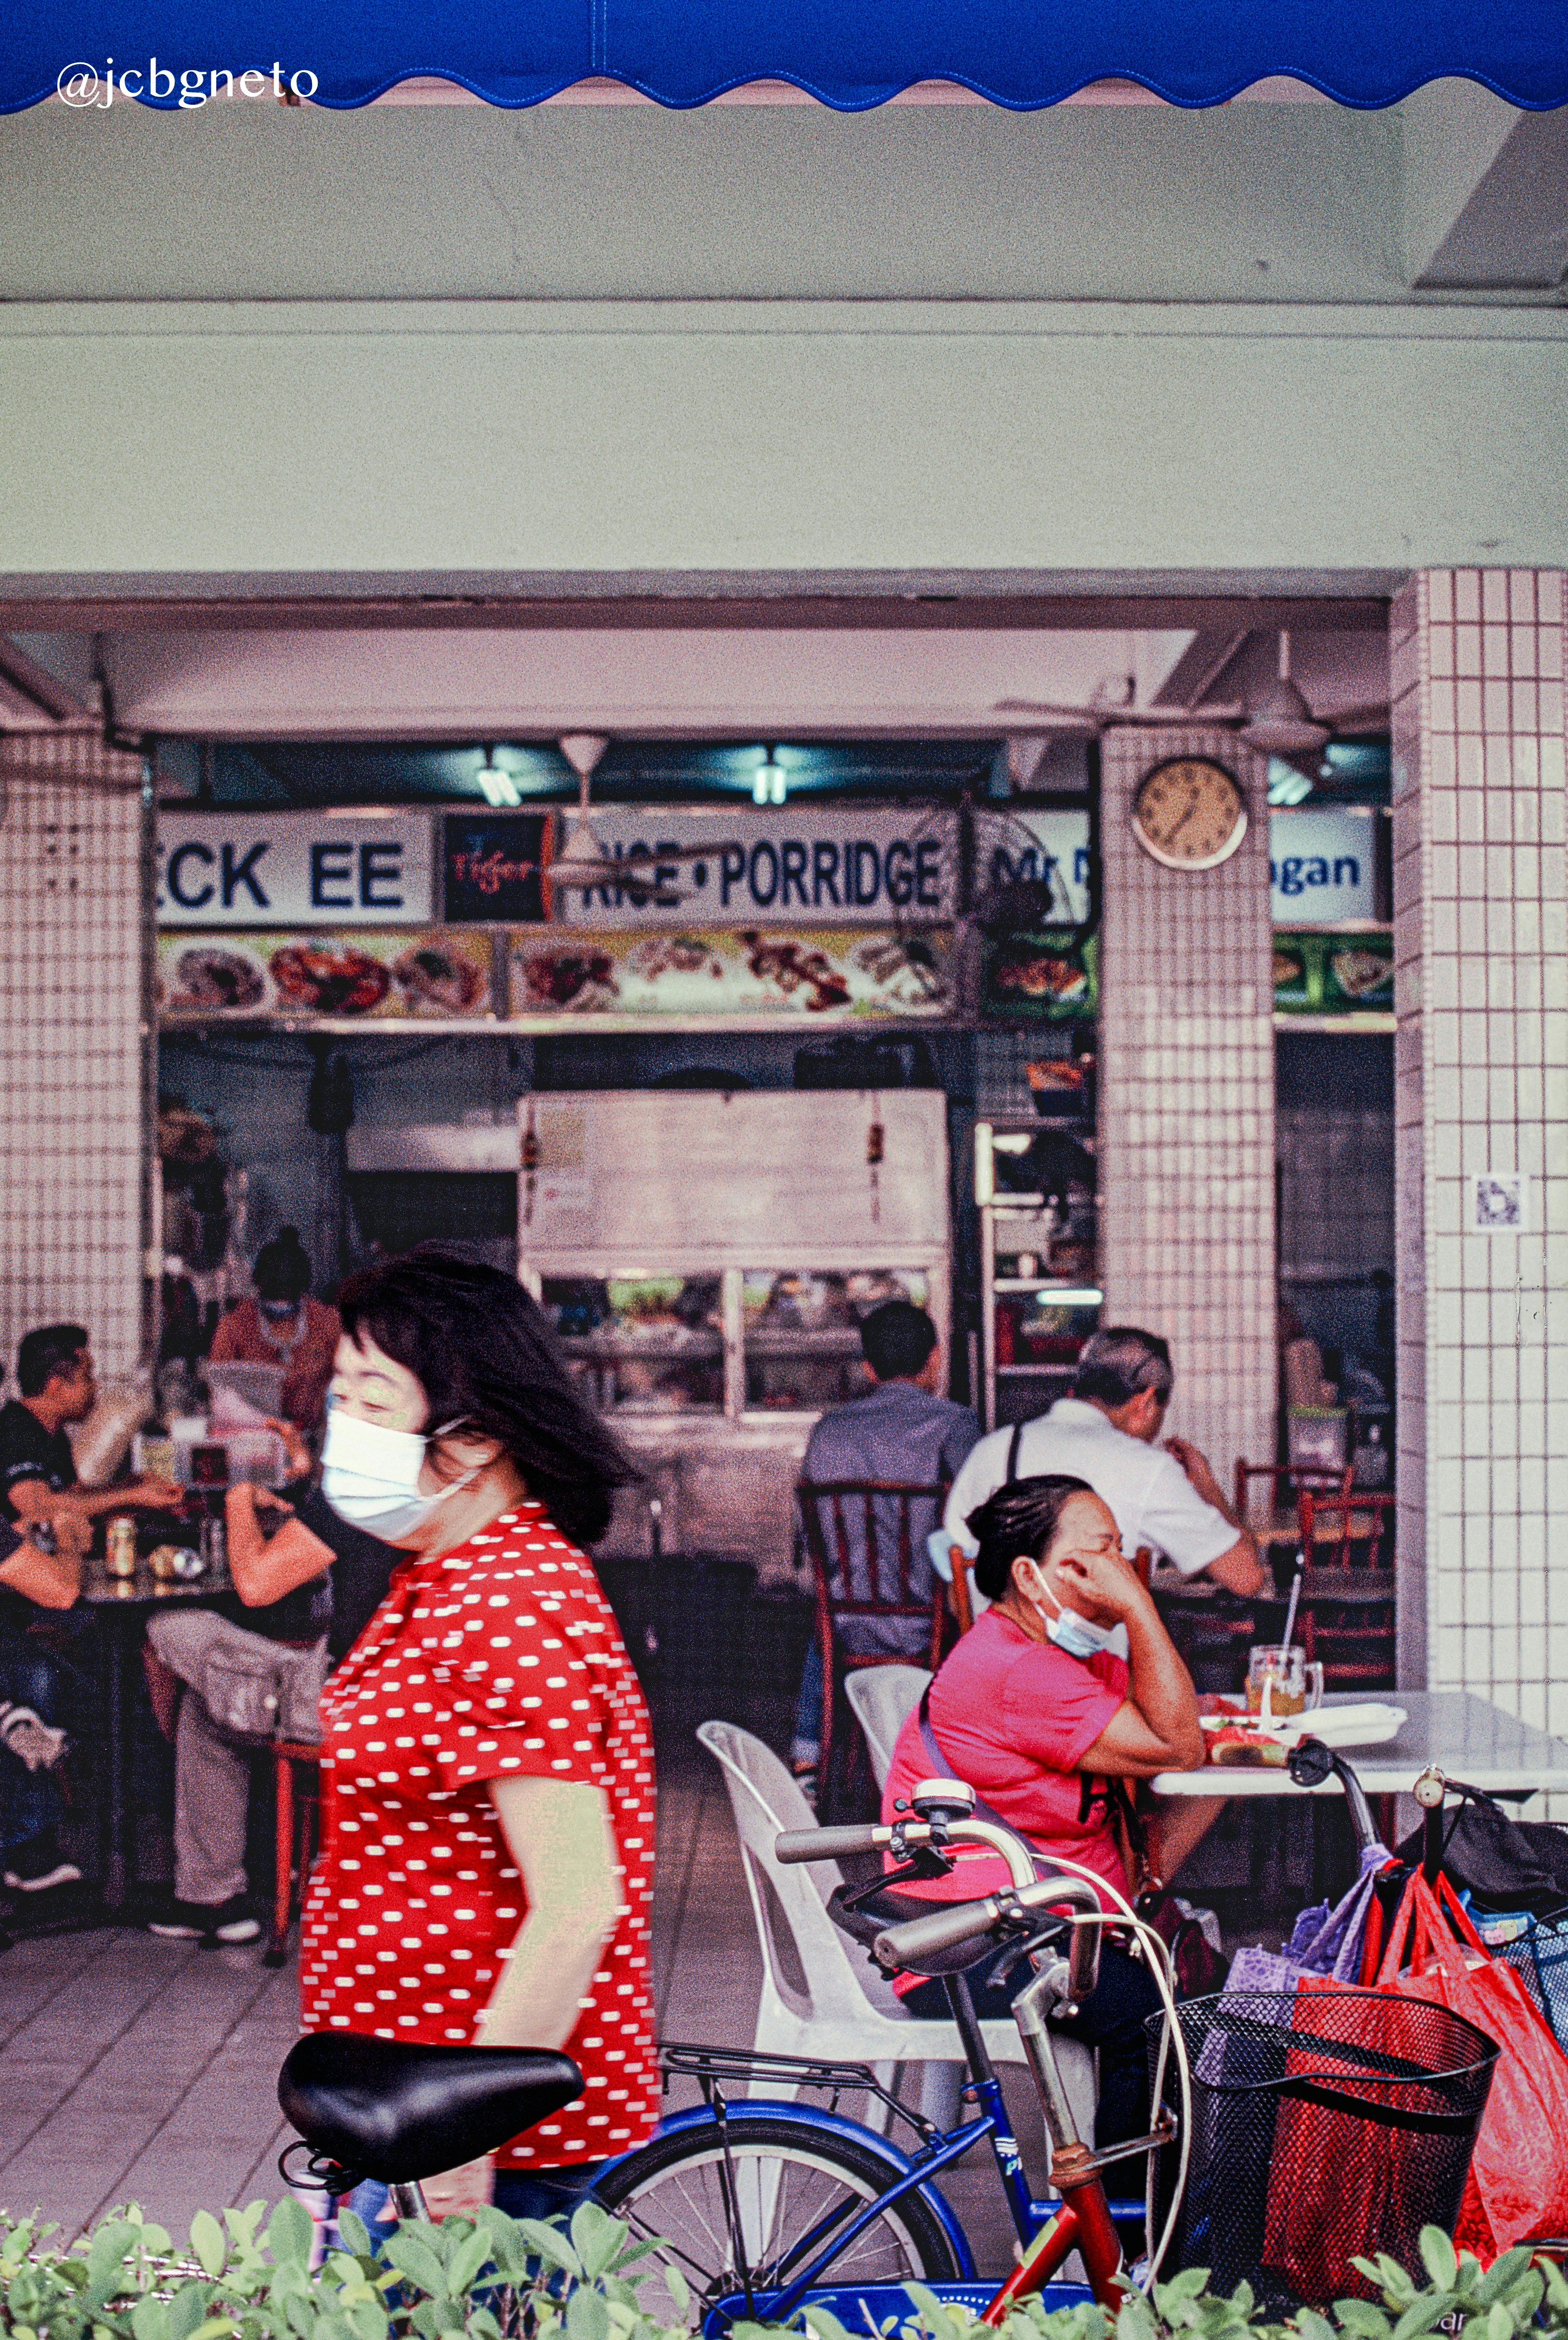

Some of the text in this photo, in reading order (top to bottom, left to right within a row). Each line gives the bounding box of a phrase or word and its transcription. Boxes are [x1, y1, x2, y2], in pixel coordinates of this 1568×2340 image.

[156, 841, 404, 908] CK EE
[720, 840, 941, 908] PORRIDGE
